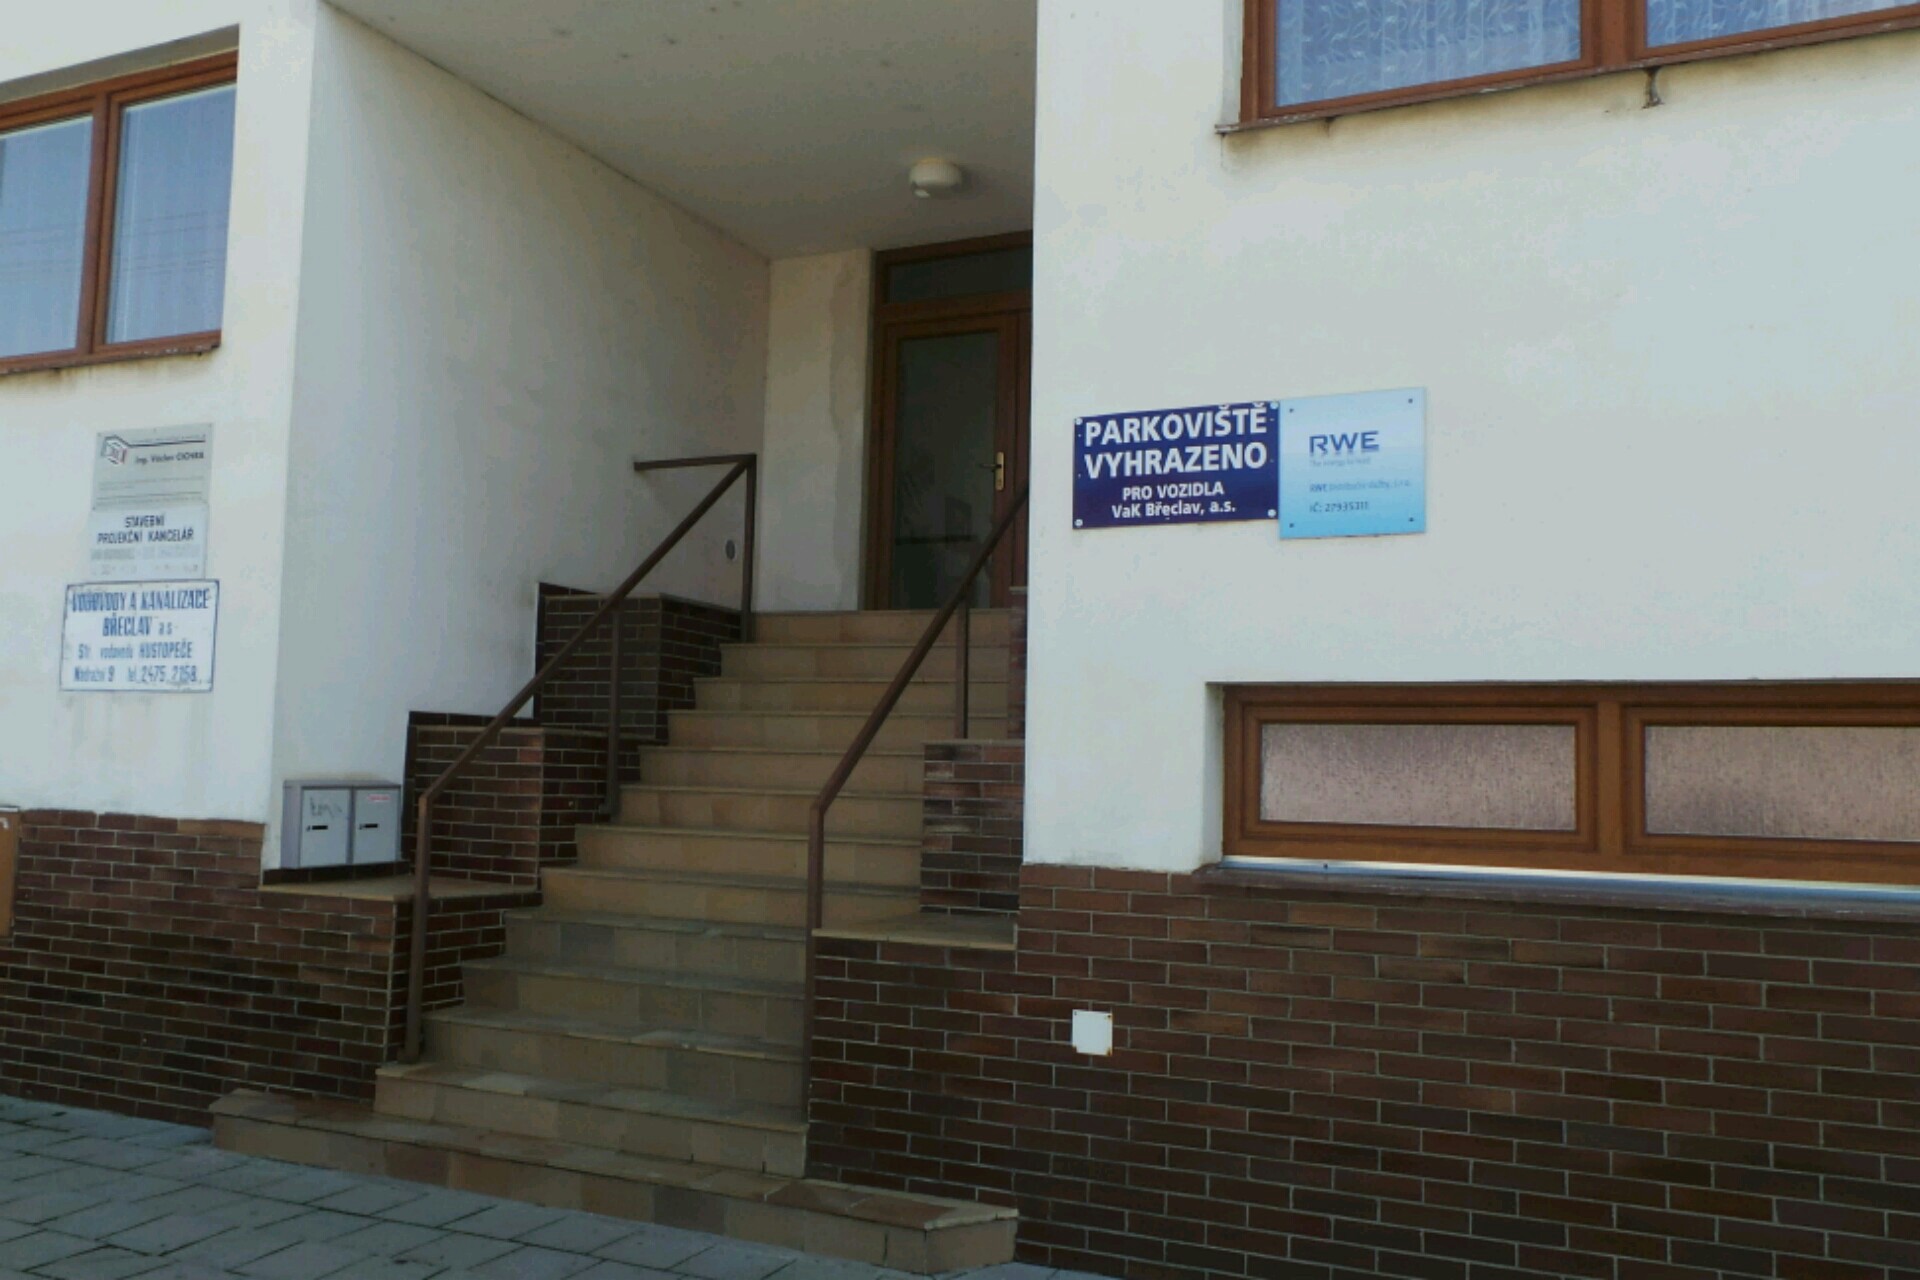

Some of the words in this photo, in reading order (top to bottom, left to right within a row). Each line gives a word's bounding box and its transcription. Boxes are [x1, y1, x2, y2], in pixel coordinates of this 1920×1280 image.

[1084, 402, 1267, 447] PARKOVIŠTĚ
[1309, 430, 1380, 455] RWE
[1084, 442, 1268, 479] VYHRAZENO
[1123, 486, 1152, 501] PRO
[1157, 481, 1225, 498] VOZIDLA
[1112, 504, 1141, 518] VaK
[1145, 500, 1205, 517] Břeclav,
[1210, 501, 1236, 513] a.s.
[1309, 502, 1322, 513] IČ:
[124, 513, 165, 528] STAVEBNÍ
[97, 530, 143, 544] PROJEKČNÍ
[148, 527, 194, 542] KANCELÁŘ
[130, 592, 137, 610] A
[140, 588, 210, 611] KANALIZACE
[102, 612, 152, 637] BŘECLAV
[139, 639, 193, 659] HUSTOPEČE
